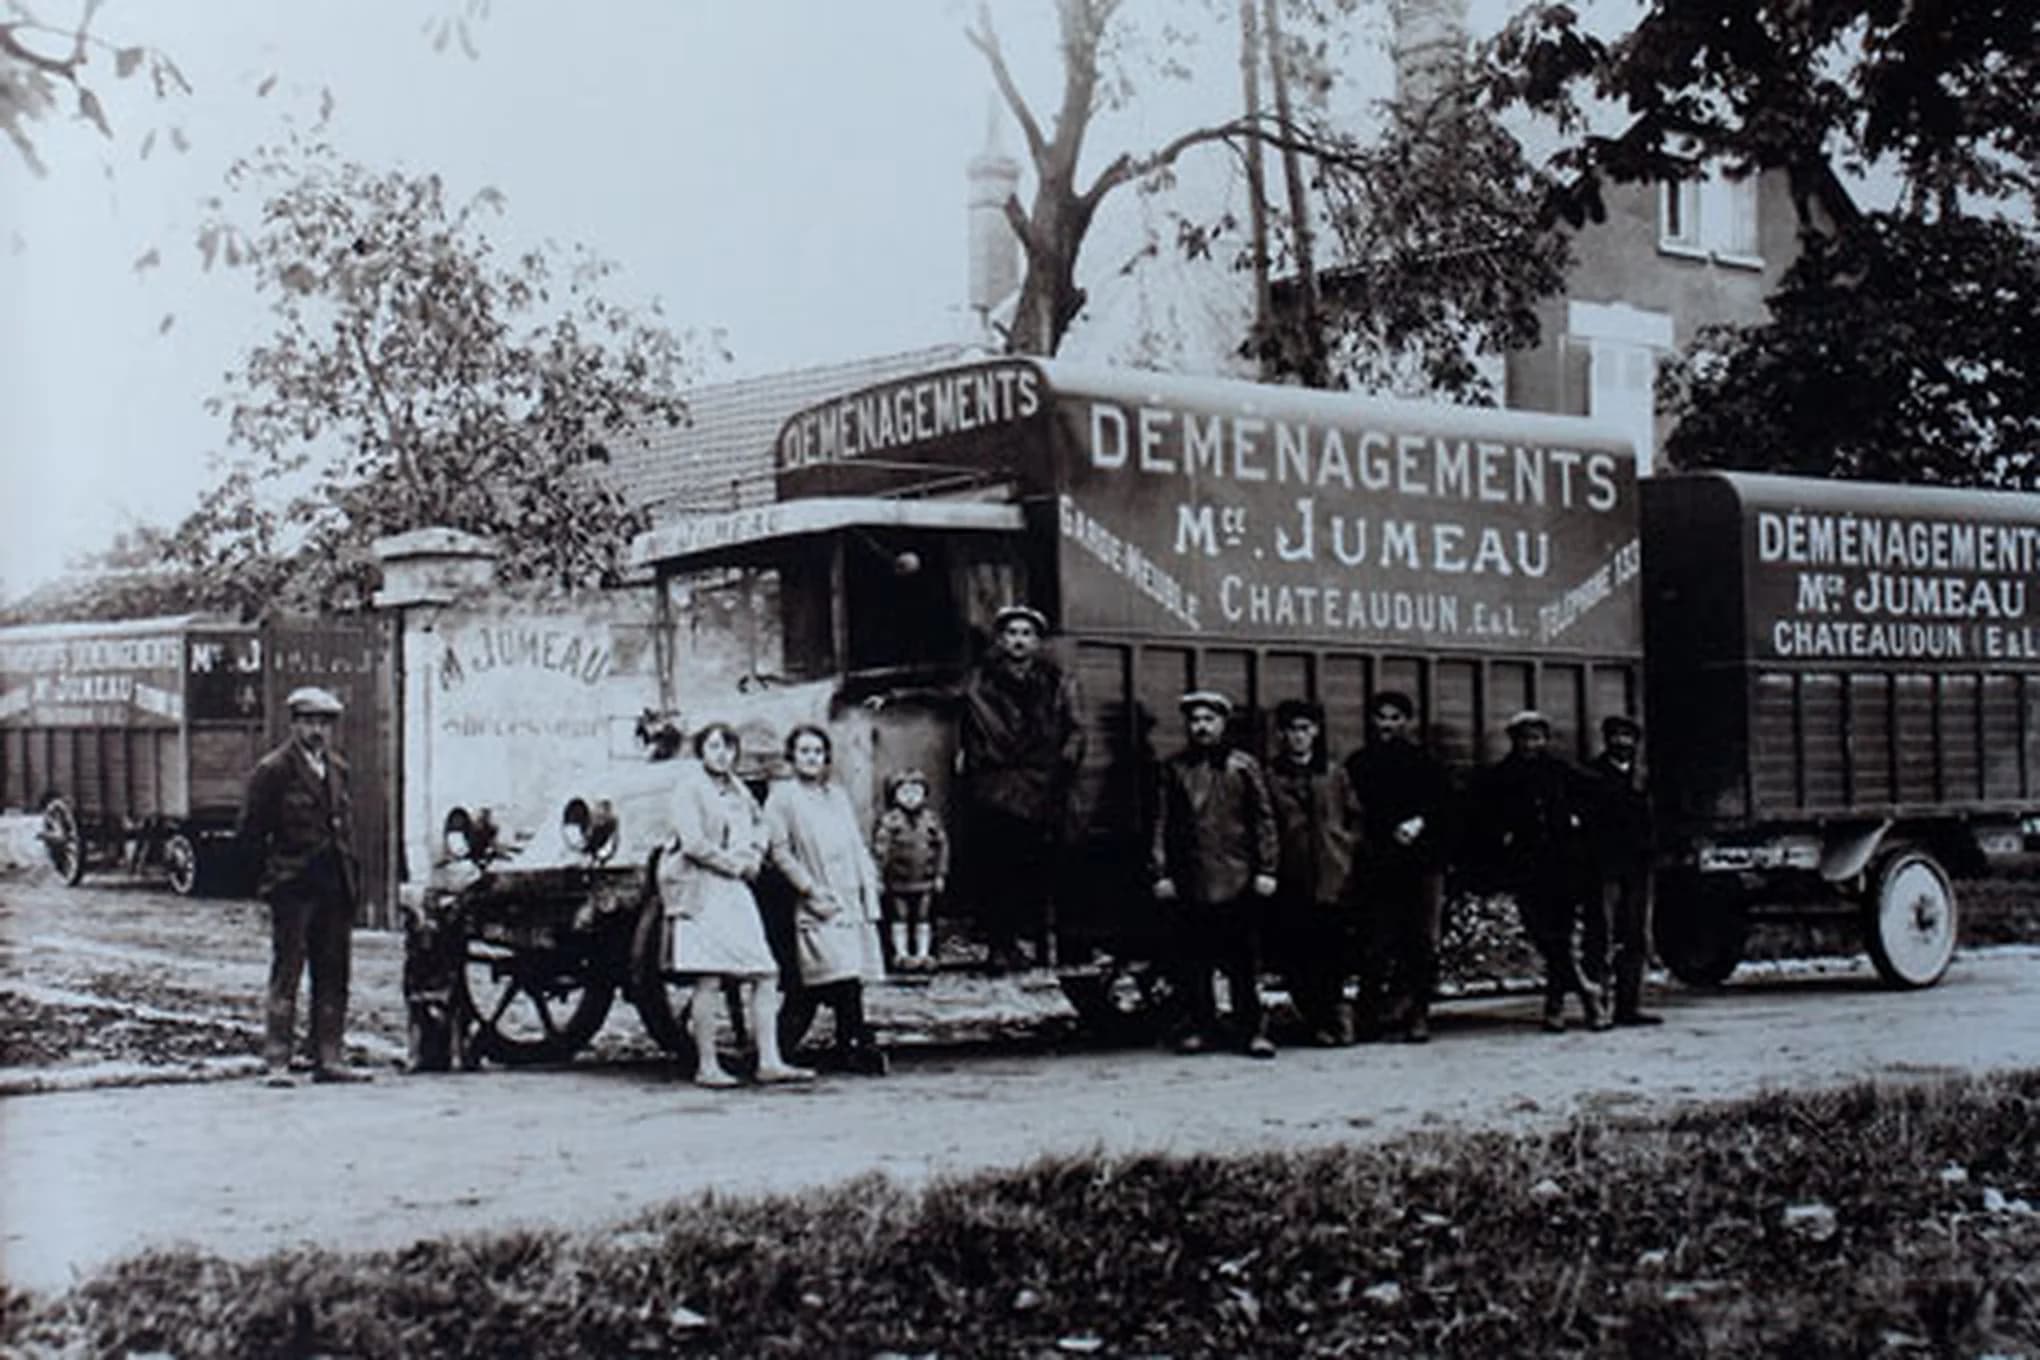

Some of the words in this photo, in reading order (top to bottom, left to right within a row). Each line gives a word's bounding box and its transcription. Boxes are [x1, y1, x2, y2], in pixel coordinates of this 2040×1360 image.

[1219, 574, 1458, 634] CHATEAUDUN
[1852, 570, 2026, 618] JUMEAU
[1773, 620, 1963, 657] CHATEAUDUN
